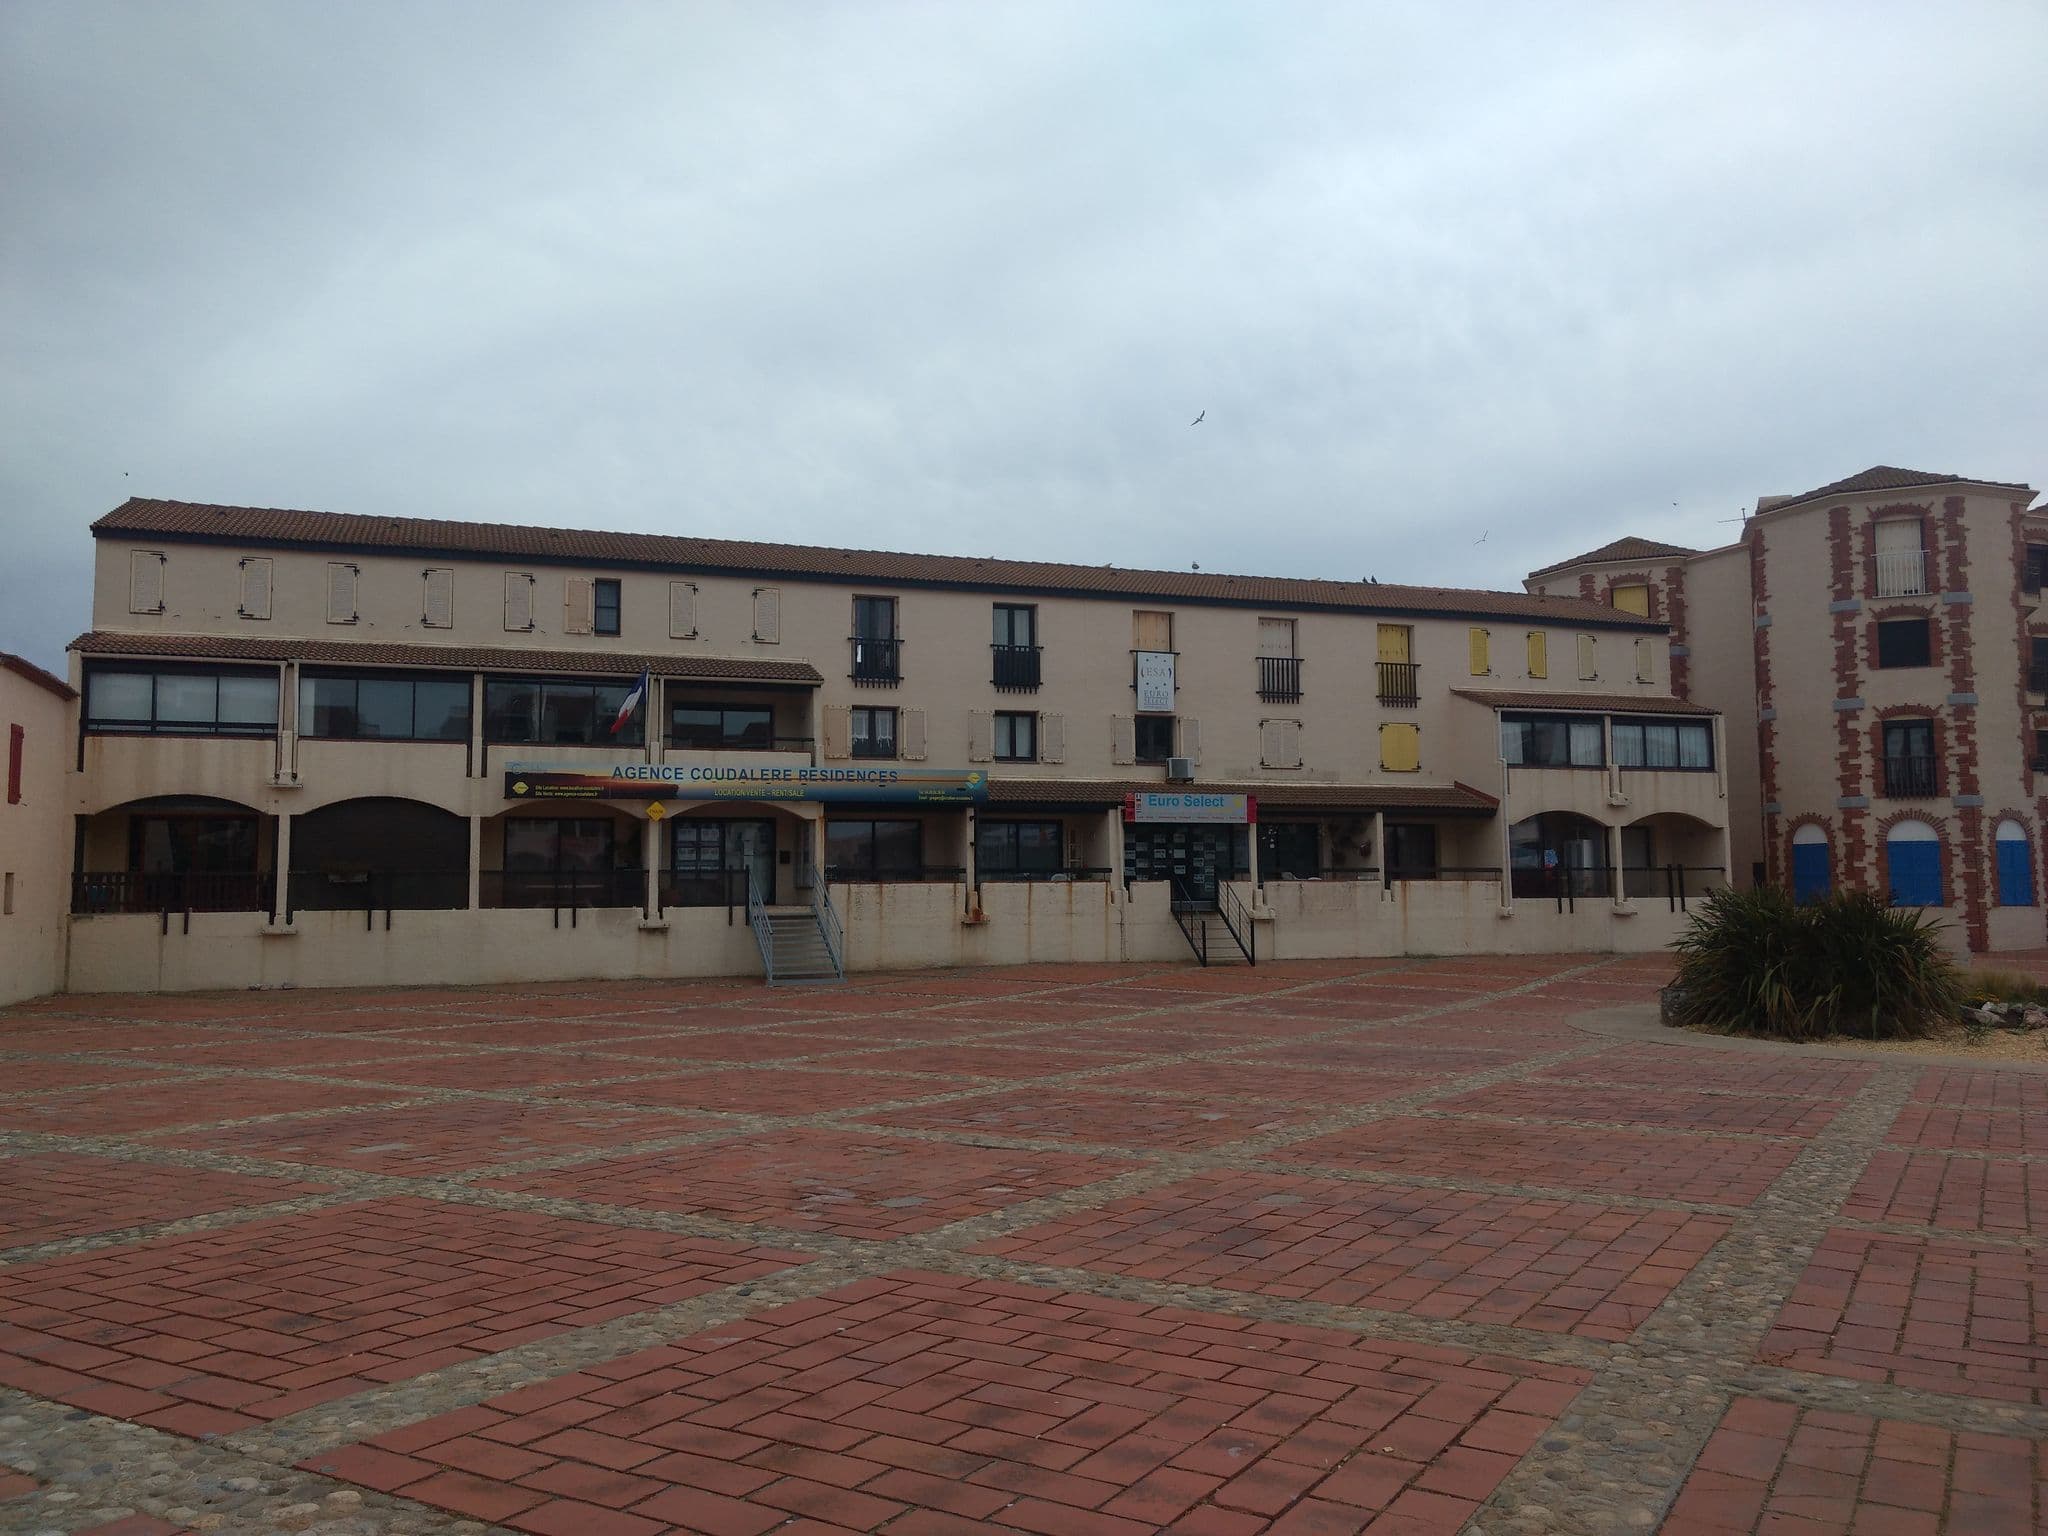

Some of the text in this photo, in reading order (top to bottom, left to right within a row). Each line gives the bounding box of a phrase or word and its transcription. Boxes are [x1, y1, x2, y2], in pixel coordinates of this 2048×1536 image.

[612, 767, 898, 783] AGENCE COUDALERE RESIDENCES
[1148, 794, 1225, 808] Euro Select
